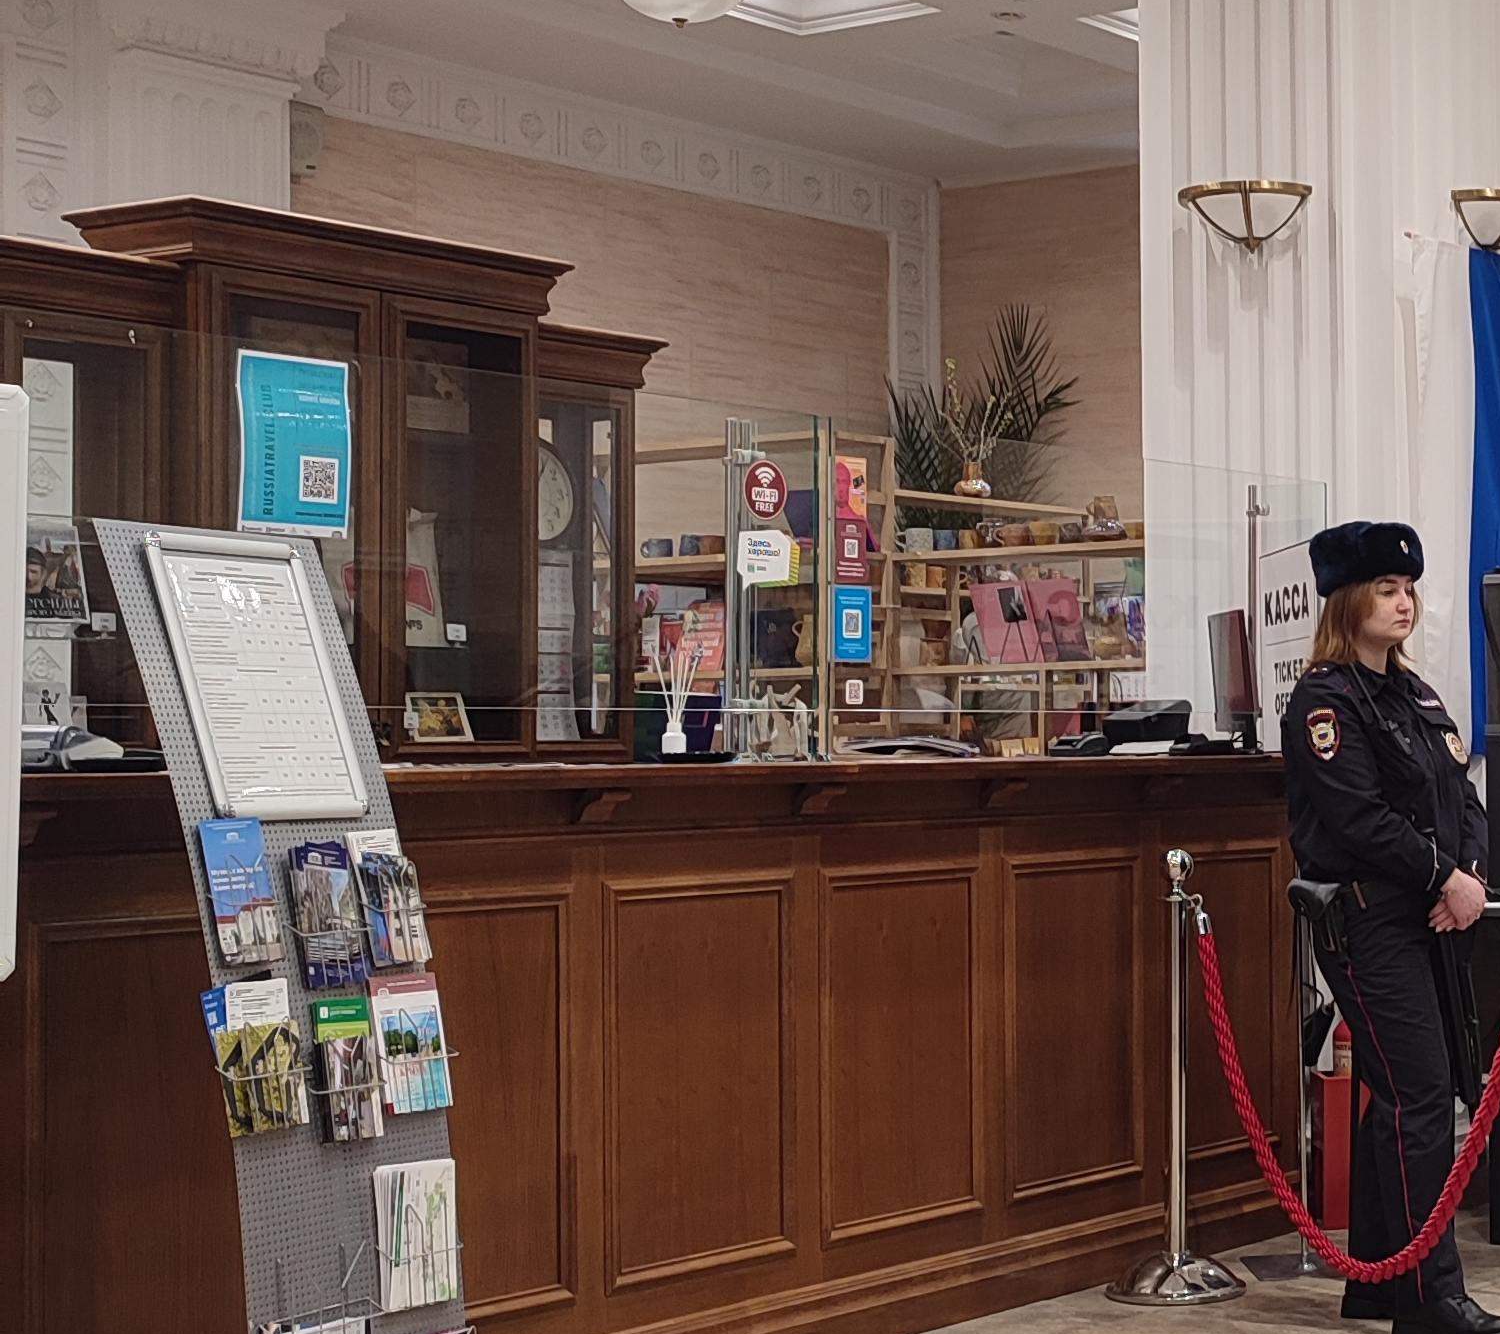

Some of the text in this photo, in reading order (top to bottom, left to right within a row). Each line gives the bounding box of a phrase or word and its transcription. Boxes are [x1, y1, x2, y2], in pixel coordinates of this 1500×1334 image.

[755, 502, 774, 512] FREE
[1264, 582, 1310, 627] КАССА
[1274, 658, 1304, 684] TICKET
